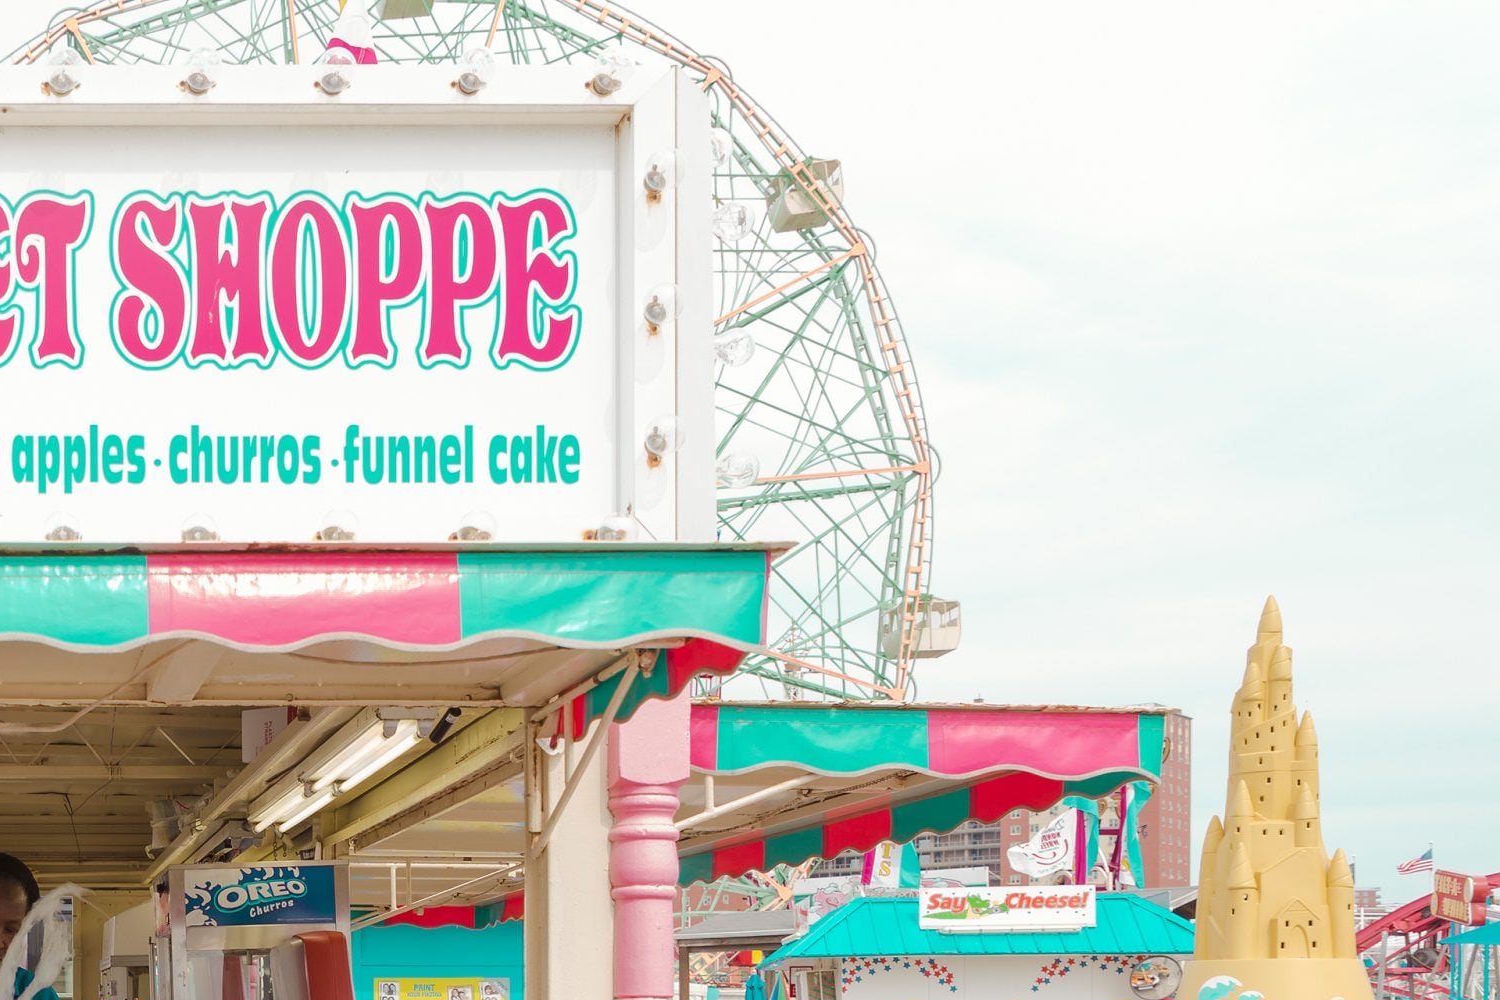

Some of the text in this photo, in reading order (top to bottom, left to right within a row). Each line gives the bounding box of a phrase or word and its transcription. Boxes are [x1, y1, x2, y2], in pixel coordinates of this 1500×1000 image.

[112, 192, 580, 368] SHOPPE
[10, 423, 147, 495] apples
[168, 423, 322, 485] churros
[342, 423, 475, 485] funnel
[487, 423, 582, 485] cake
[217, 880, 305, 909] OREO
[927, 893, 967, 914] Say
[1005, 892, 1089, 910] Cheese!
[249, 899, 294, 918] Churros
[413, 983, 436, 992] PRINT
